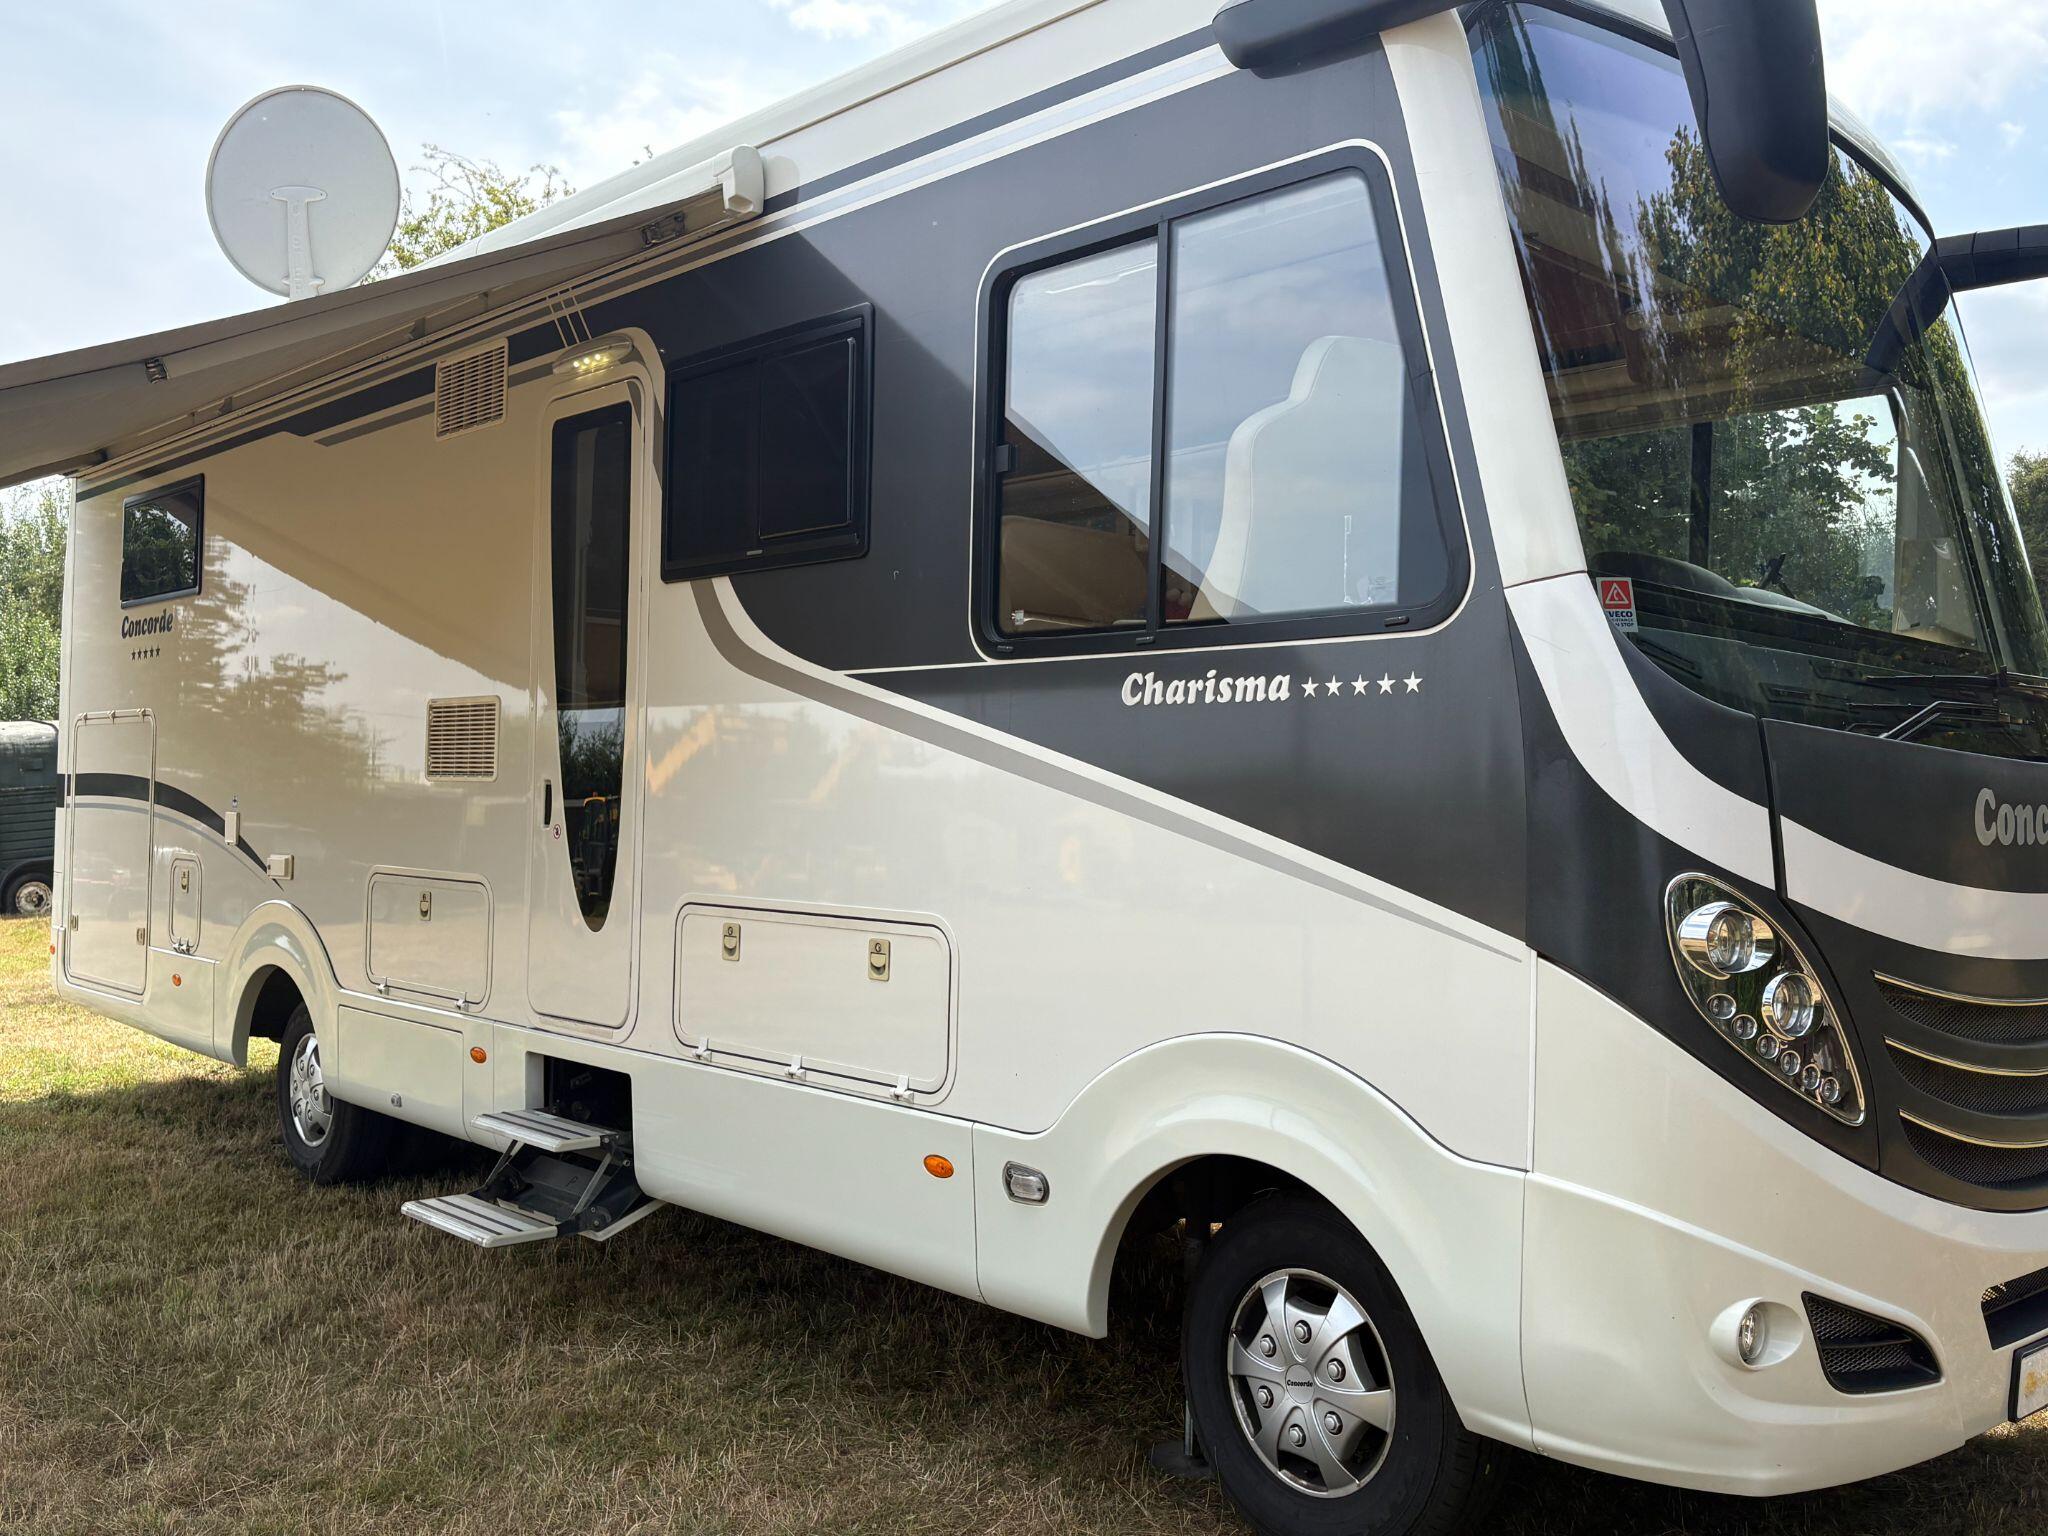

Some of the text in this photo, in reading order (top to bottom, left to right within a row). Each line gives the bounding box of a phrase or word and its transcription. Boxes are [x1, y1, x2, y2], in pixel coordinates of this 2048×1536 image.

[121, 608, 174, 639] Concorde
[1608, 610, 1633, 618] VECO
[1121, 669, 1291, 706] Charisma
[1974, 787, 2048, 846] Conc
[1286, 1379, 1313, 1388] Concorde
